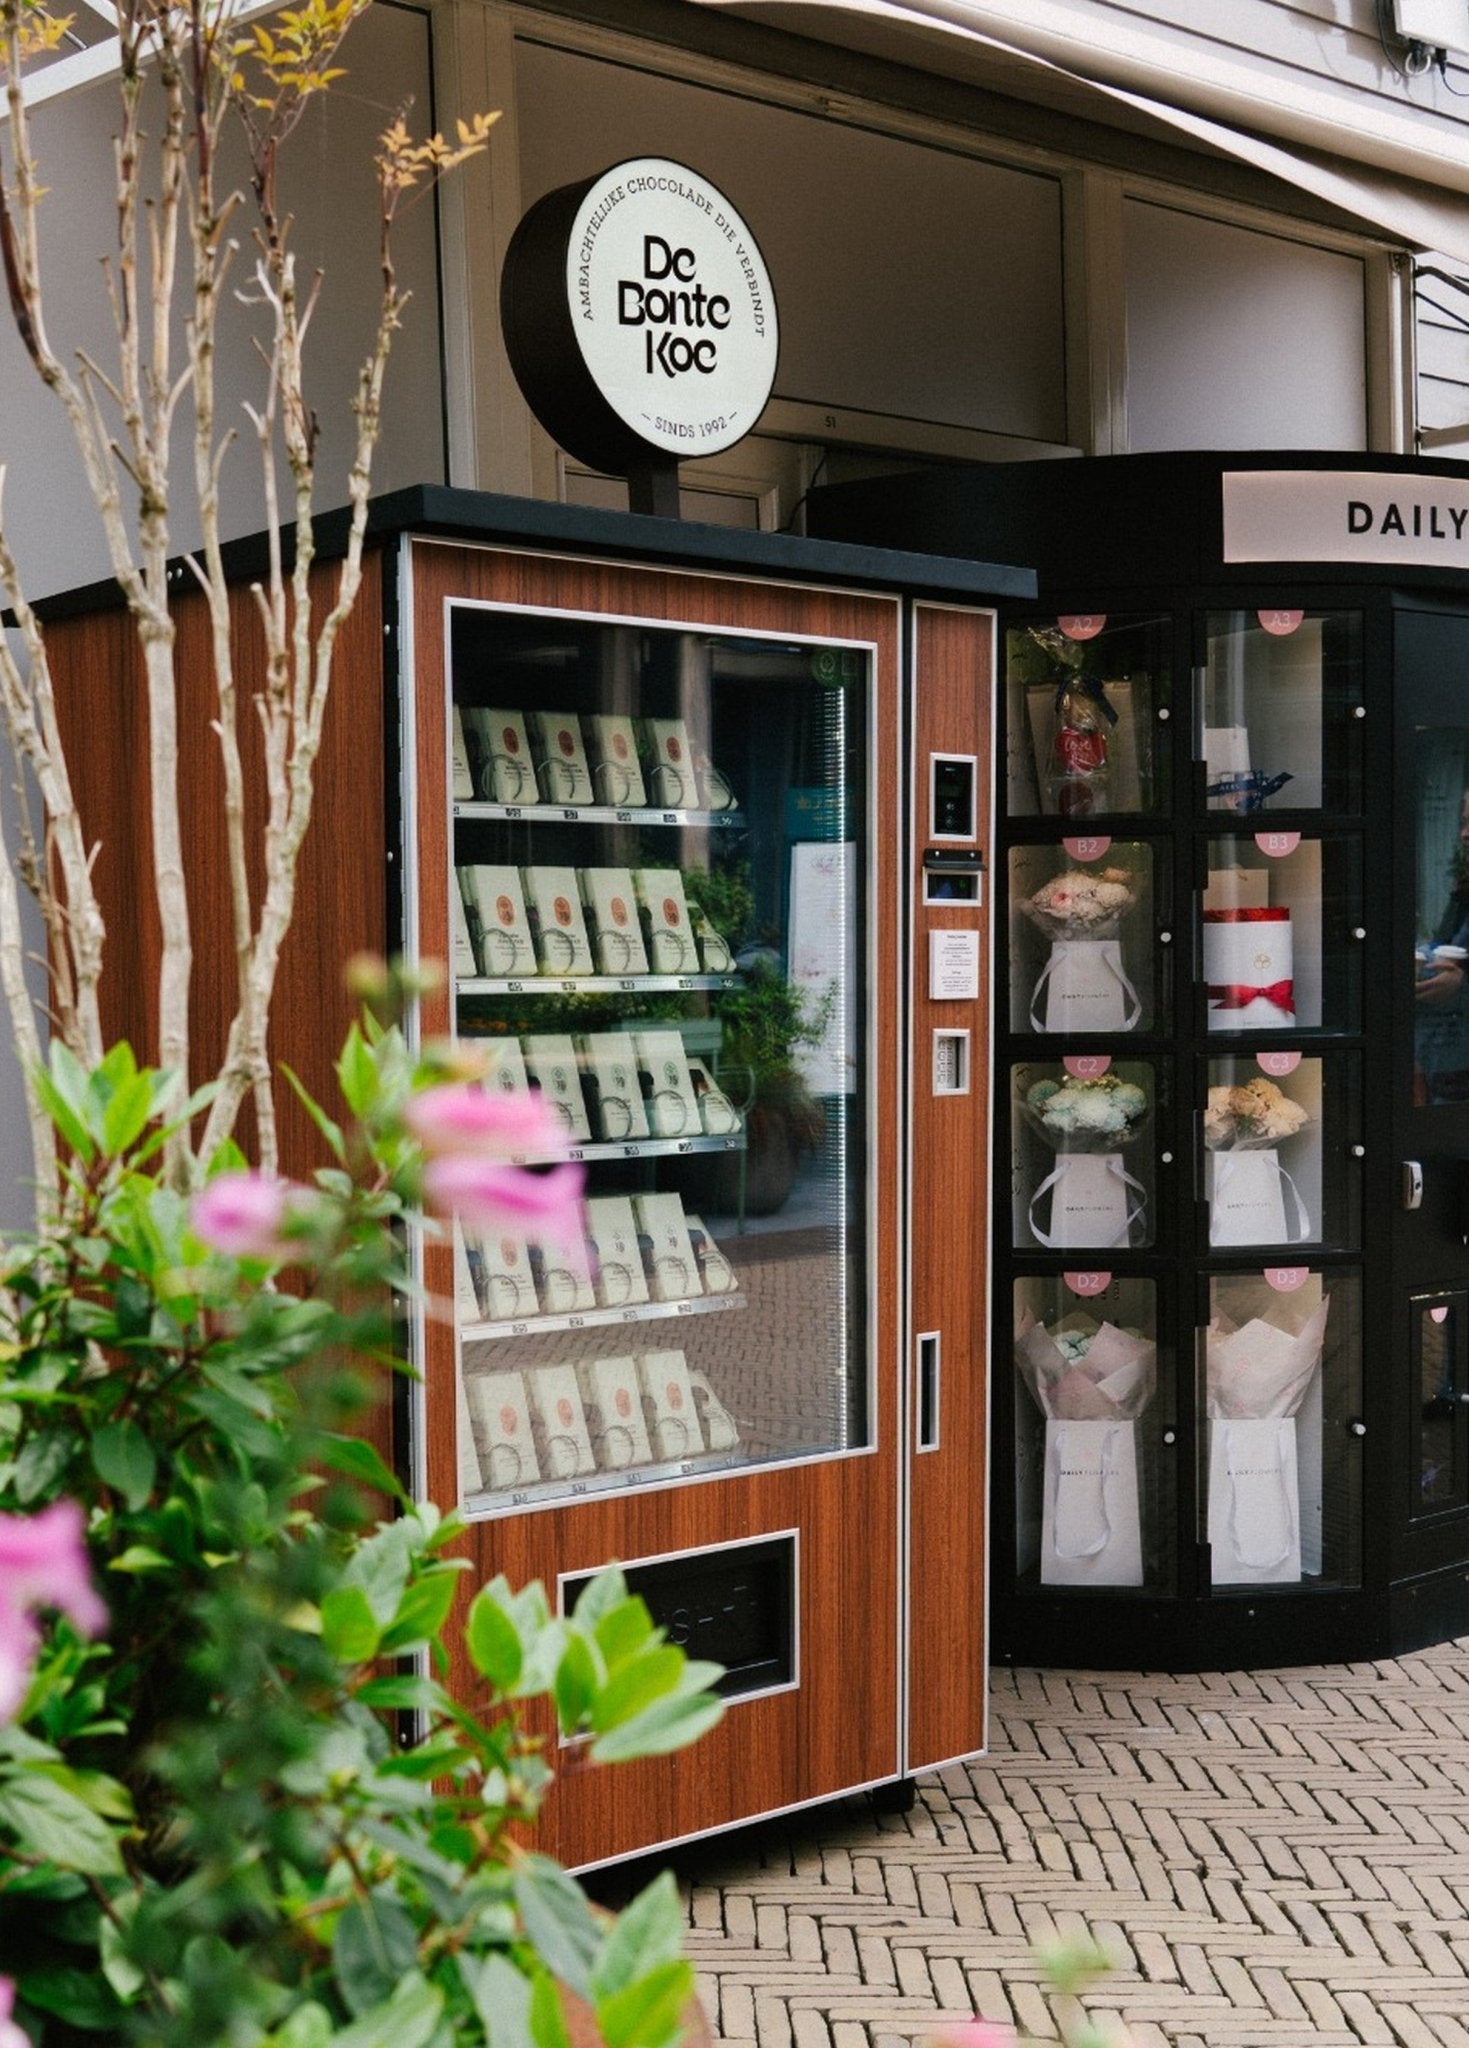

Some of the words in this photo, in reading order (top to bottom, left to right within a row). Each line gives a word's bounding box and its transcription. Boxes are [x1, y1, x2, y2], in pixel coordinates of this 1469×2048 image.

[579, 185, 626, 321] AMBACHTELIJKE
[627, 176, 714, 216] CHOCOLADE
[714, 212, 737, 244] DIE
[736, 243, 765, 338] VERBINDT
[643, 234, 697, 283] De
[617, 280, 731, 330] Bonte
[645, 329, 718, 379] Koe
[654, 416, 696, 438] SINDS
[698, 416, 728, 437] 1992
[1347, 501, 1469, 540] DAILY
[1071, 619, 1093, 632] A2
[1270, 614, 1291, 627] A3
[1077, 840, 1097, 853] B2
[1269, 836, 1289, 849] B3
[1077, 1059, 1097, 1072] C2
[1269, 1055, 1289, 1068] C3
[1078, 1275, 1099, 1288] D2
[1277, 1271, 1298, 1284] D3
